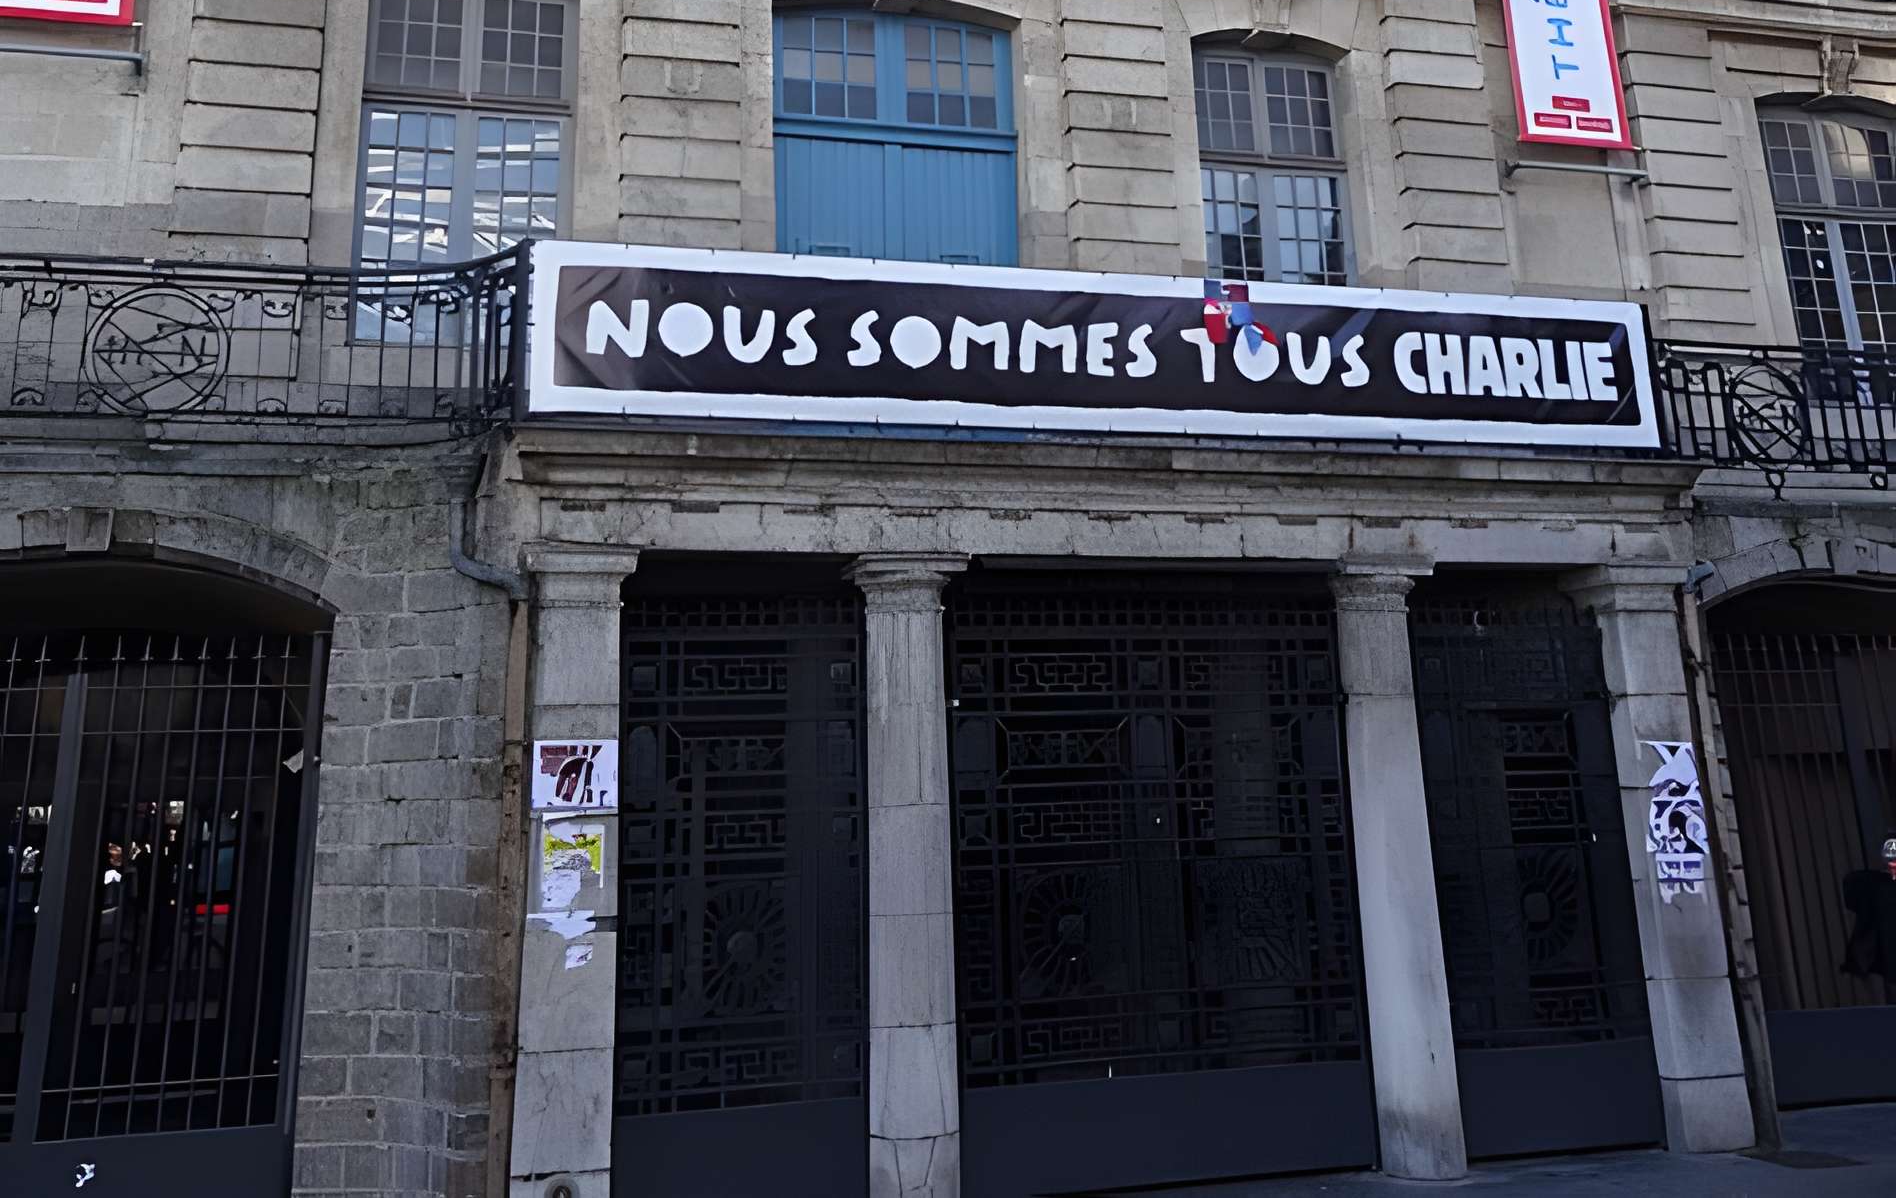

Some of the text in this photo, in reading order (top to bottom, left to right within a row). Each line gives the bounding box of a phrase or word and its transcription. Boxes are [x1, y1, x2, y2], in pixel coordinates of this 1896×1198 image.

[585, 299, 1619, 402] NOUS SOMMES TOUS CHARLIE
